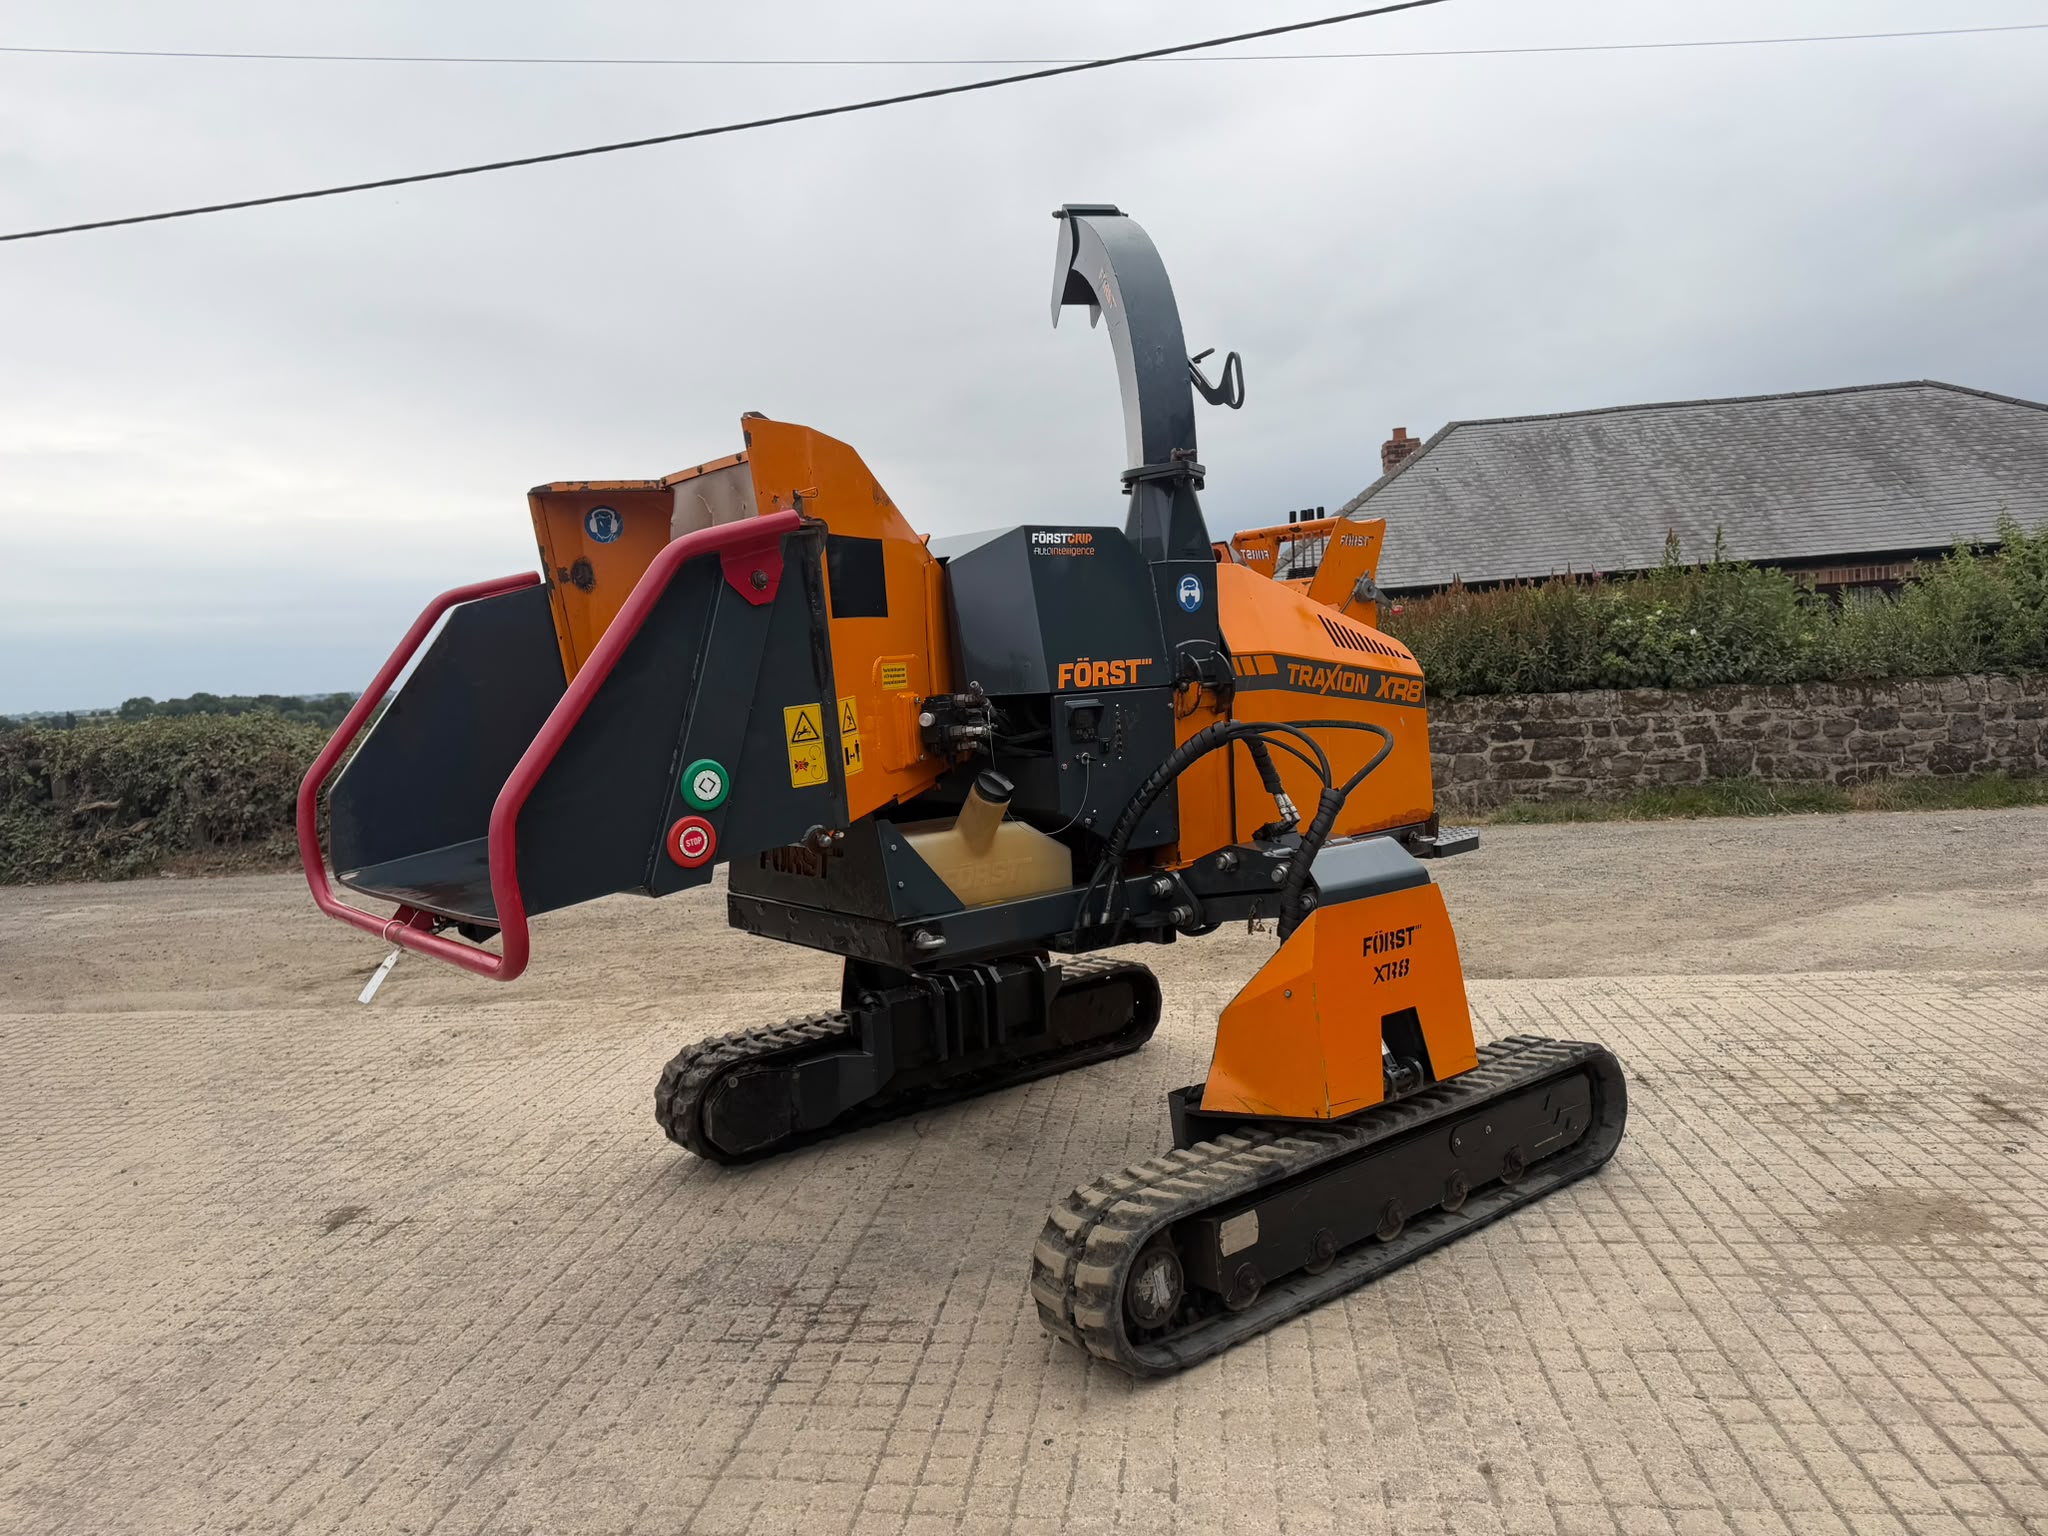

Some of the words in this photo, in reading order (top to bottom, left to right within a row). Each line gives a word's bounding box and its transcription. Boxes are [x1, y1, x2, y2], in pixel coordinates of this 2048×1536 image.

[1058, 657, 1152, 690] FÖRST
[1287, 663, 1370, 695] TRAXION
[1375, 674, 1423, 703] XR8
[685, 836, 703, 848] STOP
[1363, 924, 1422, 957] FÖRST
[1373, 958, 1410, 985] XR8
